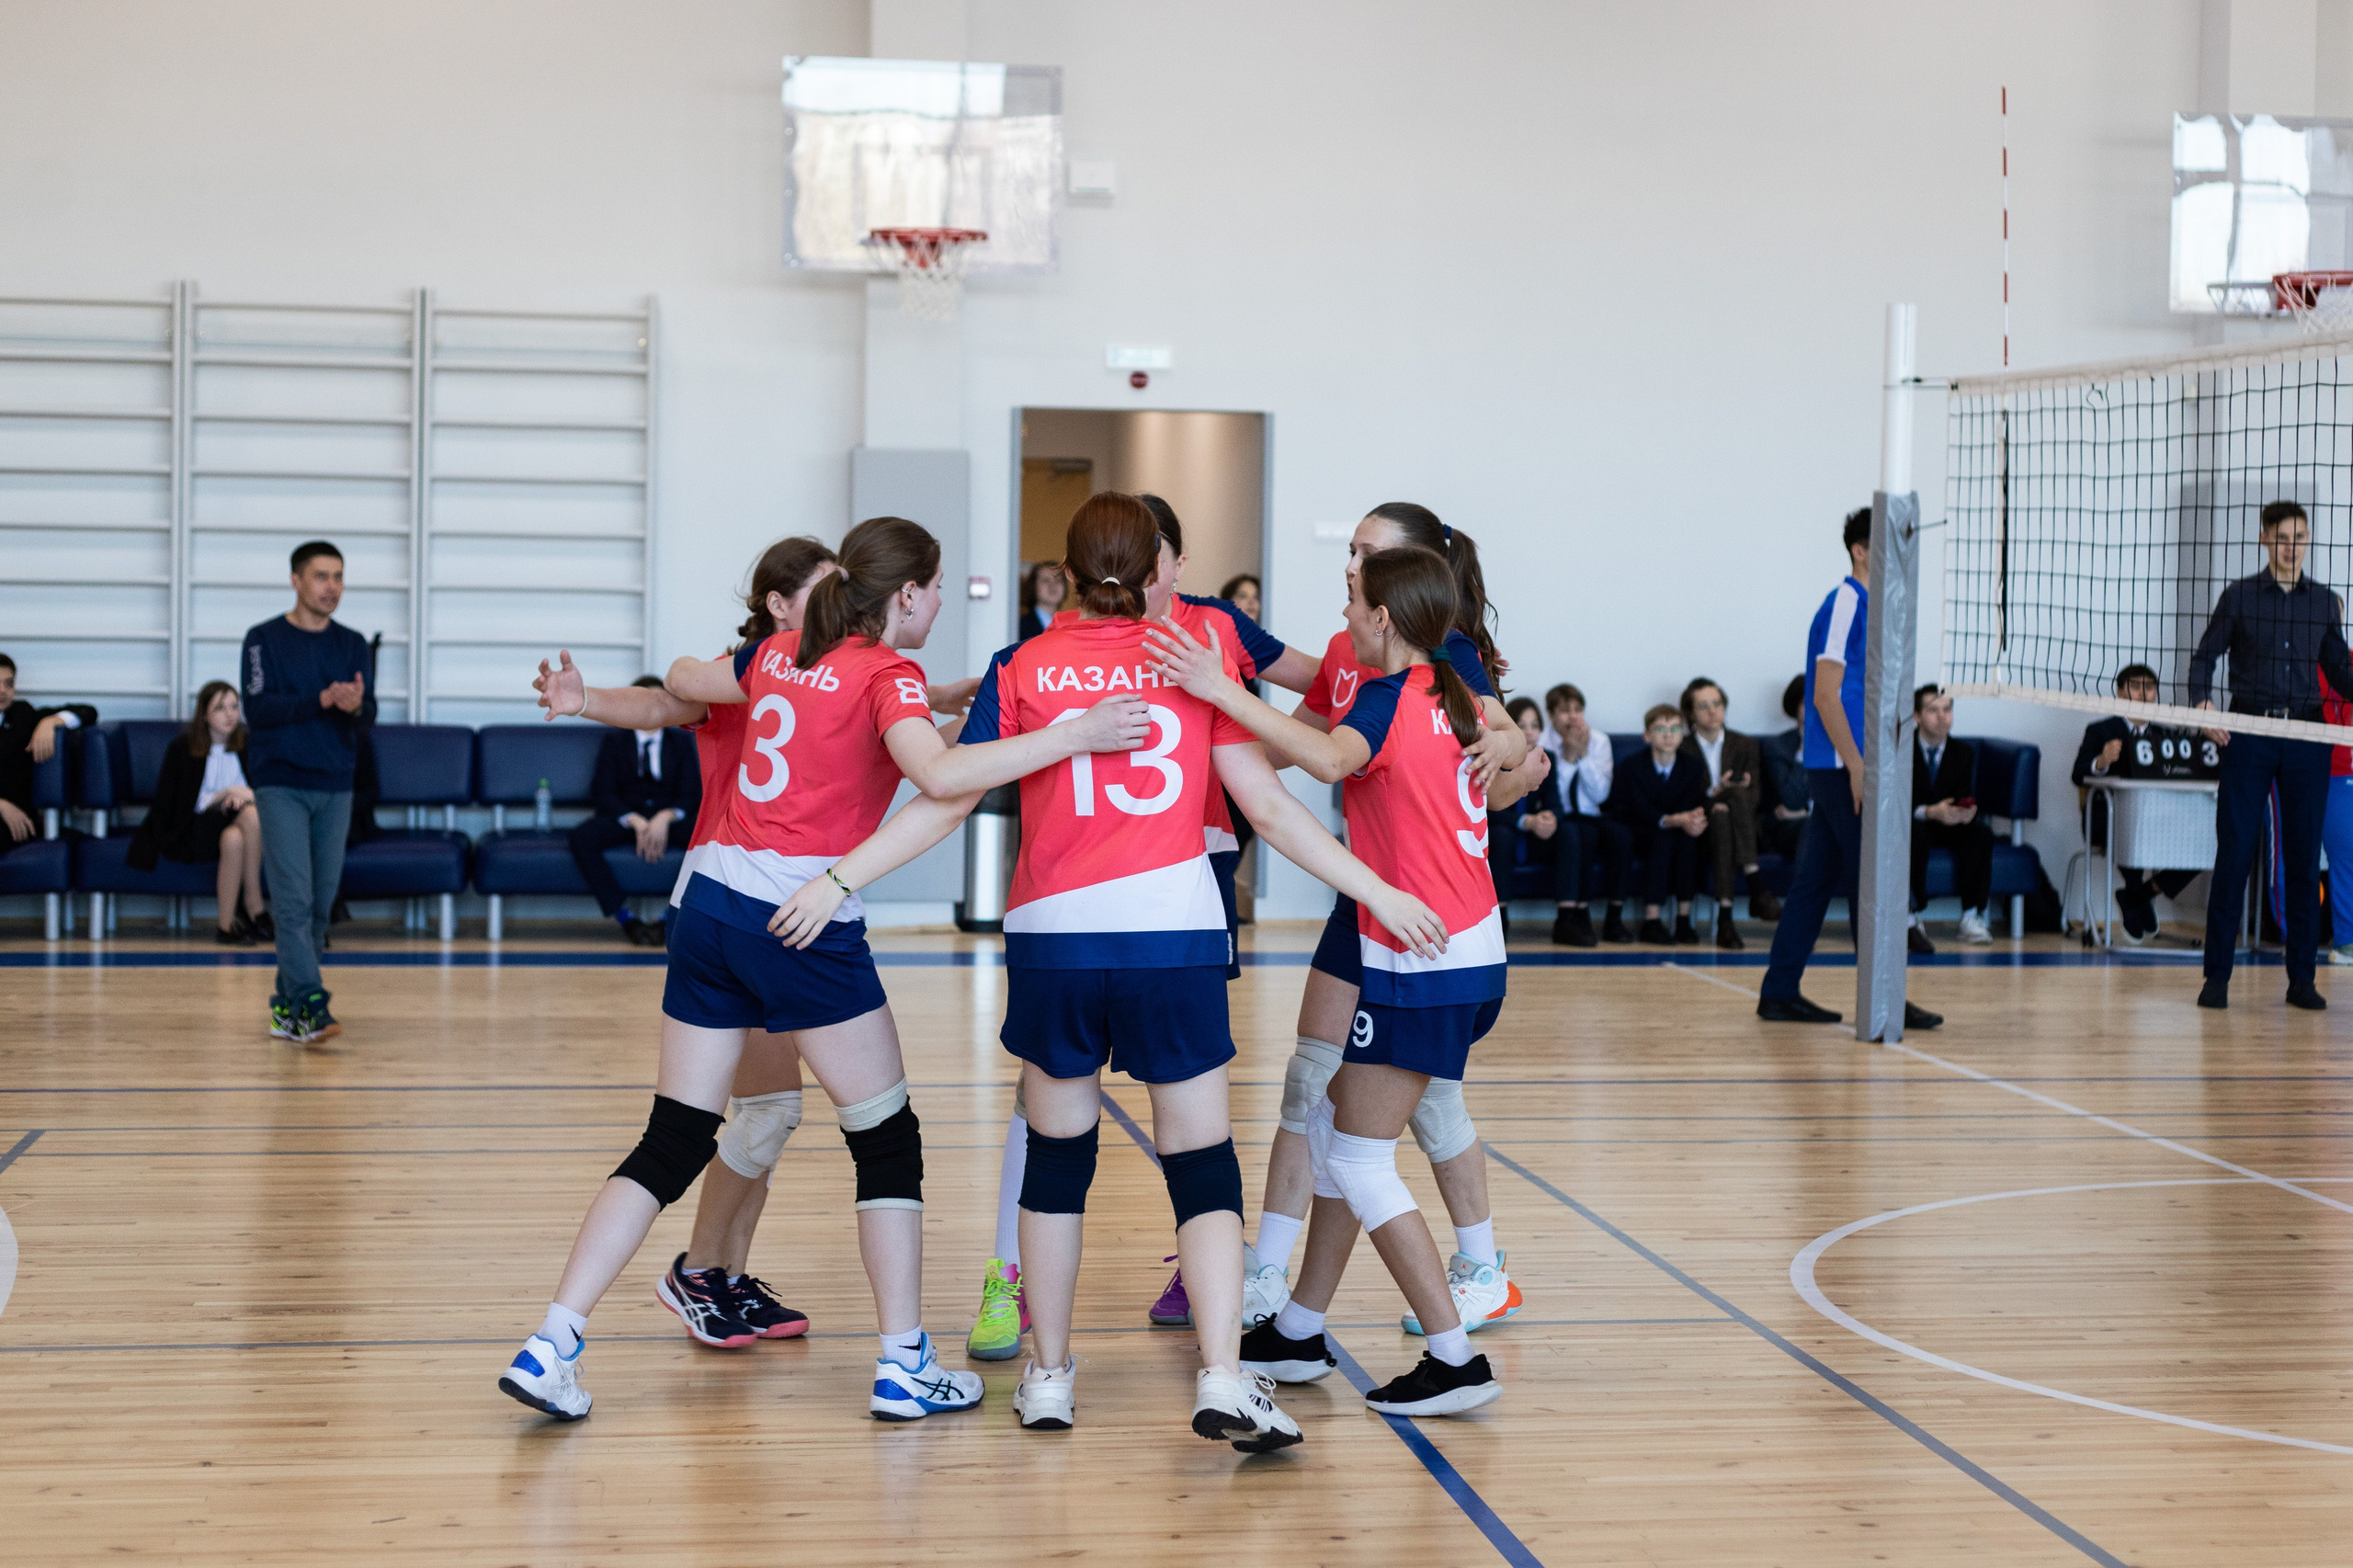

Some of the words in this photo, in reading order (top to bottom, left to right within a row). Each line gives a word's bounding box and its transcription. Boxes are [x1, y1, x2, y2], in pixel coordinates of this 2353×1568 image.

[738, 693, 796, 802] 3
[1046, 704, 1184, 816] 13
[2136, 739, 2154, 766] 6
[2201, 740, 2219, 767] 3
[1352, 1010, 1374, 1048] 9
